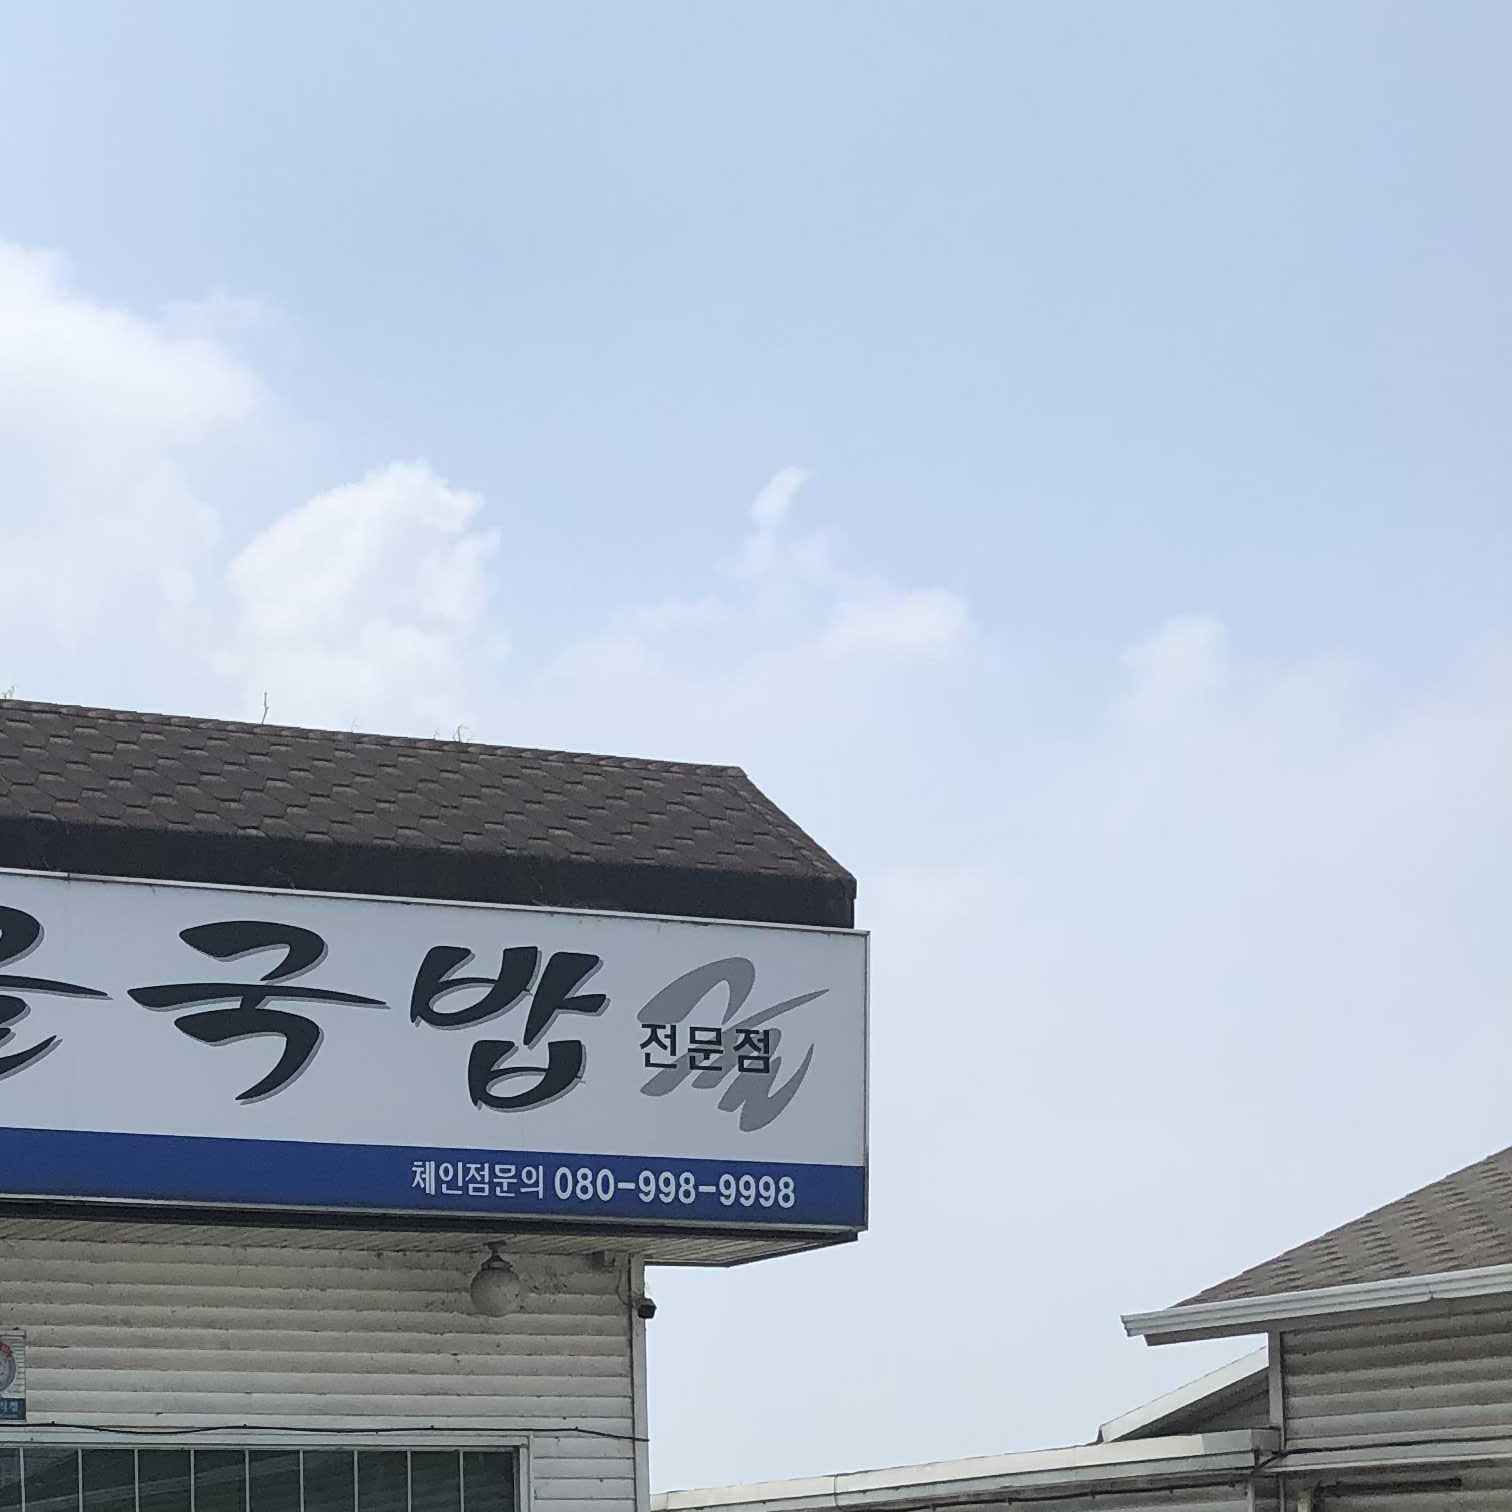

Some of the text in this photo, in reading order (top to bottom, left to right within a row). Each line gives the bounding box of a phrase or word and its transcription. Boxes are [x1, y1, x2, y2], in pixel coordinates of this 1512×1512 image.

[639, 1023, 772, 1074] 전문점
[410, 1159, 797, 1209] 체인점문의 080-998-9998
